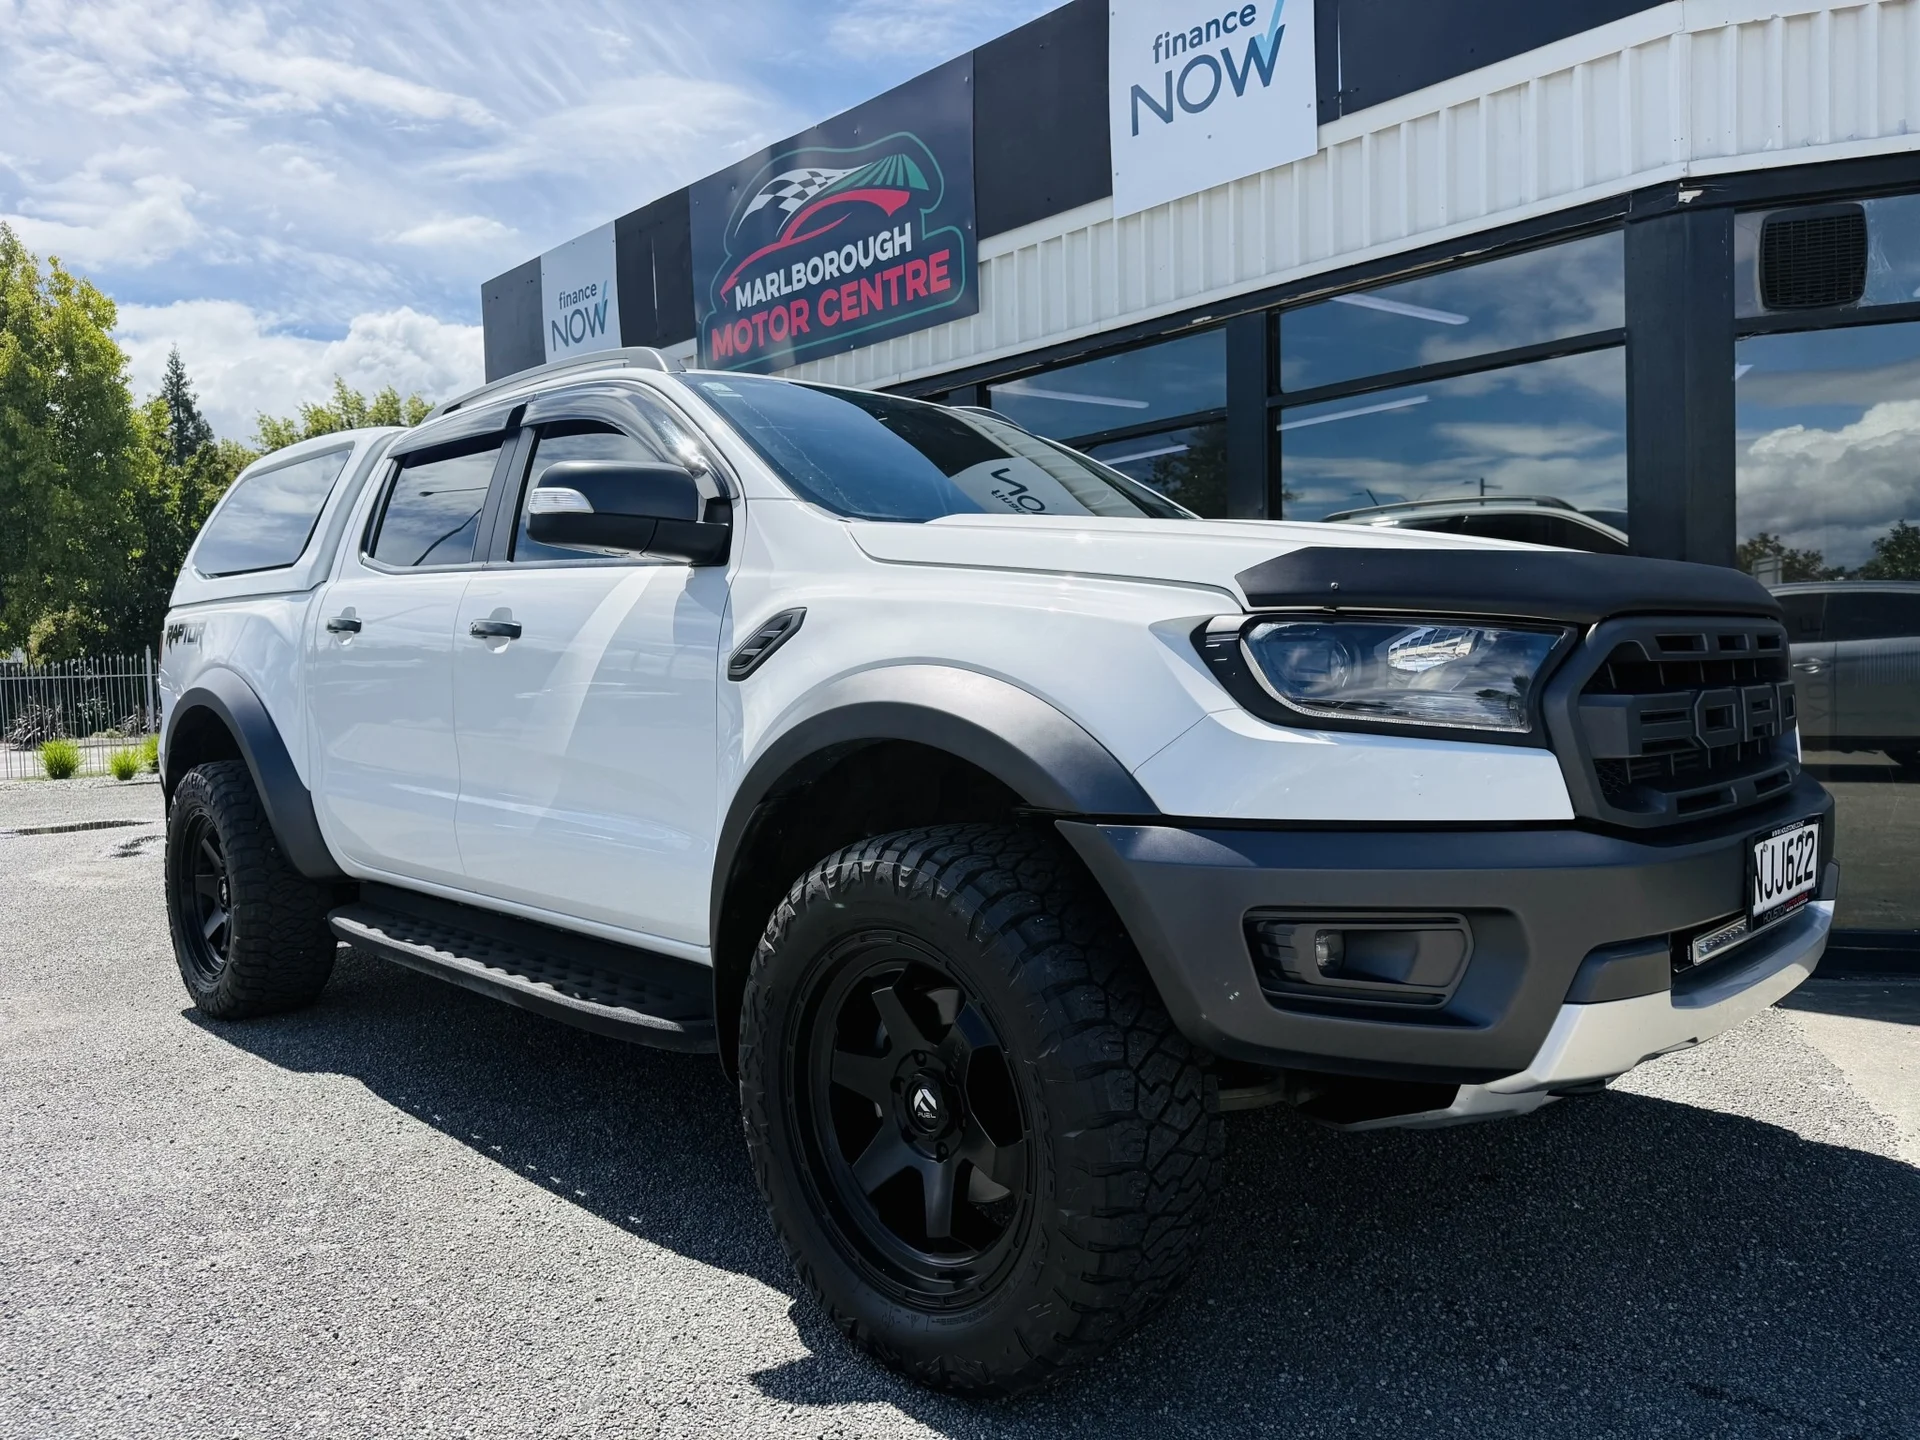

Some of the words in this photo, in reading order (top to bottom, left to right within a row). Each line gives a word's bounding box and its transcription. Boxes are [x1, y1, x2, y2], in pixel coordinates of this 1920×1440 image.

[1152, 4, 1256, 64] finance
[1130, 24, 1286, 137] NOW
[558, 282, 598, 310] finance
[734, 221, 912, 312] MARLBOROUGH
[551, 297, 608, 352] NOW
[710, 298, 810, 361] MOTOR
[818, 249, 951, 326] CENTRE
[166, 623, 206, 654] RAPTOR
[1754, 830, 1815, 906] NJJ622
